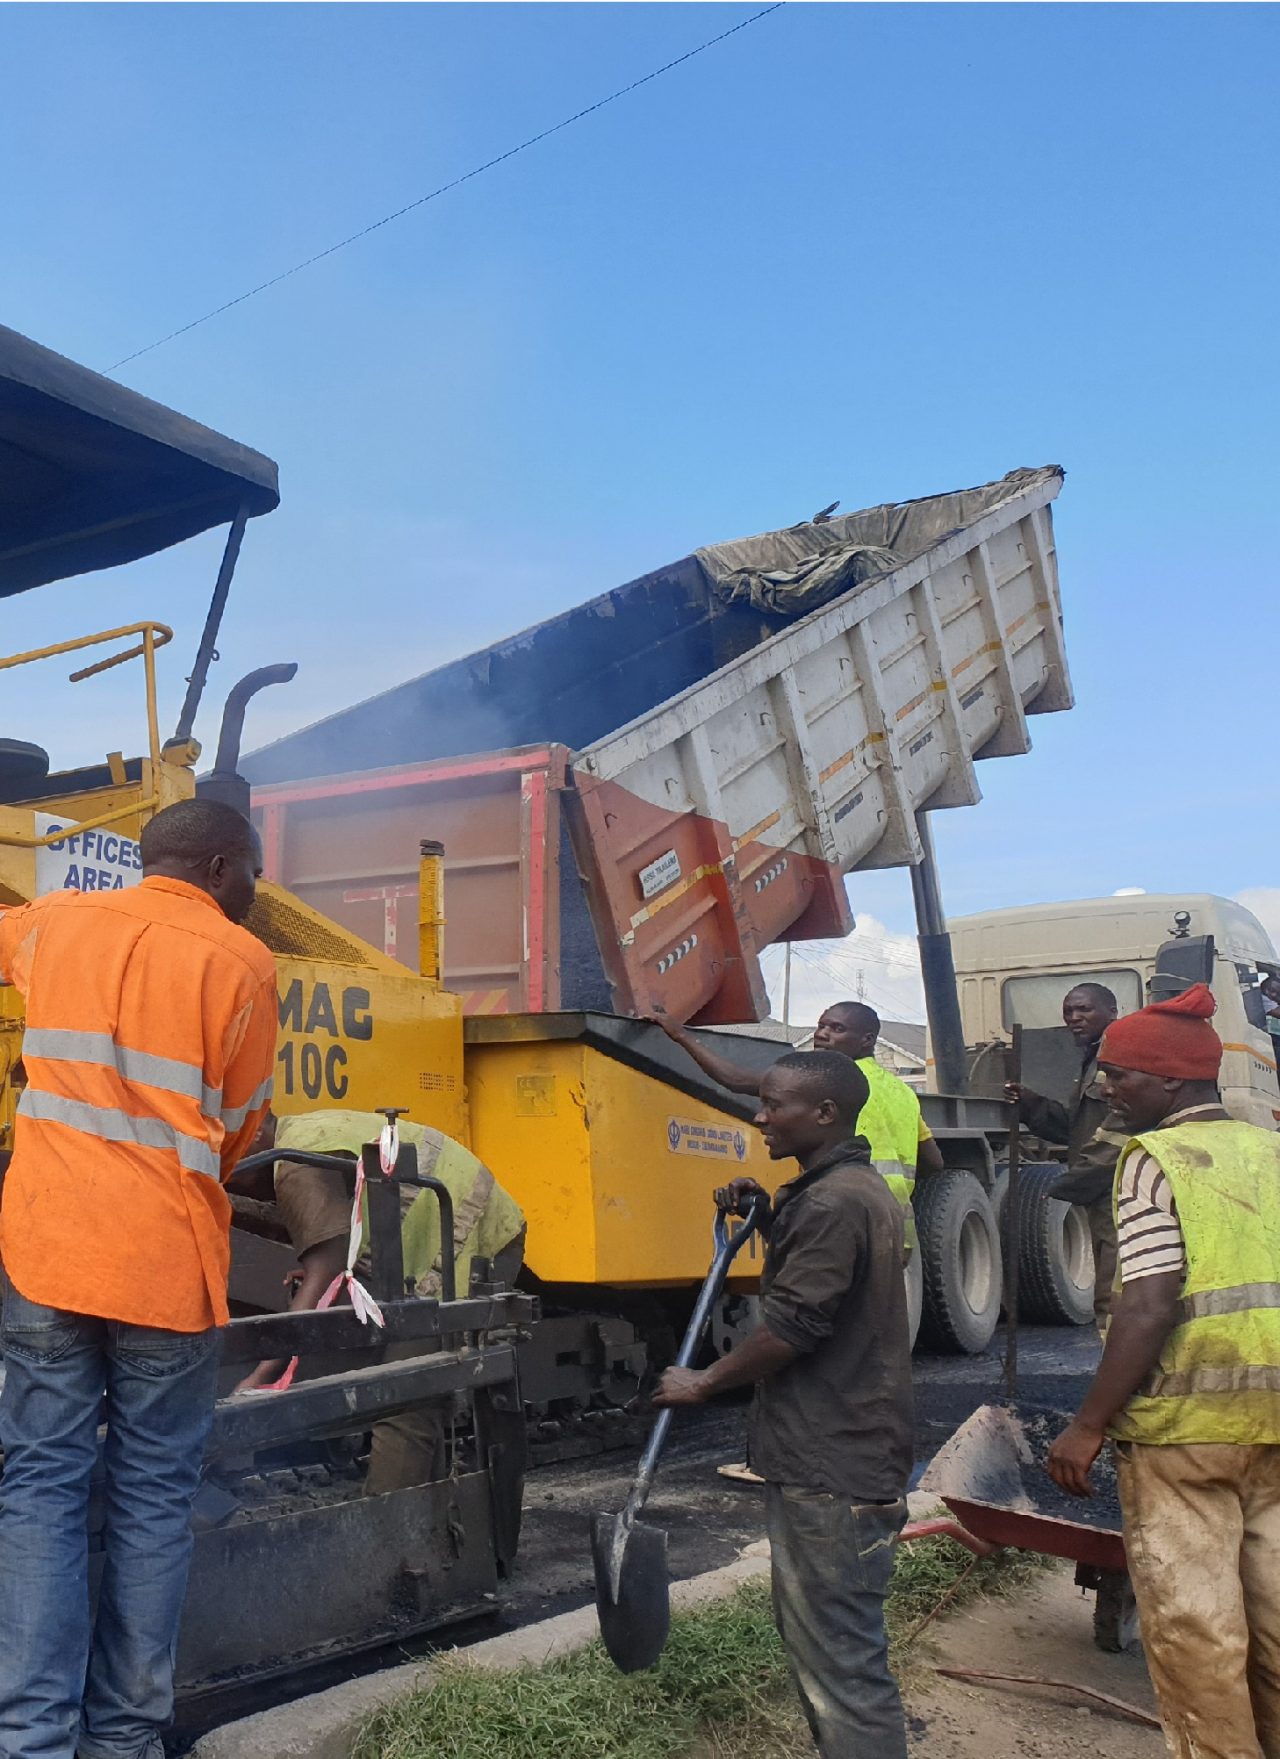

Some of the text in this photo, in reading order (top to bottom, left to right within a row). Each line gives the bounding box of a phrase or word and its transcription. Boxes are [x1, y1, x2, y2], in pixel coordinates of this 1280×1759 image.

[46, 825, 144, 871] OFFICES
[64, 864, 124, 892] AREA
[277, 1041, 349, 1100] 10C
